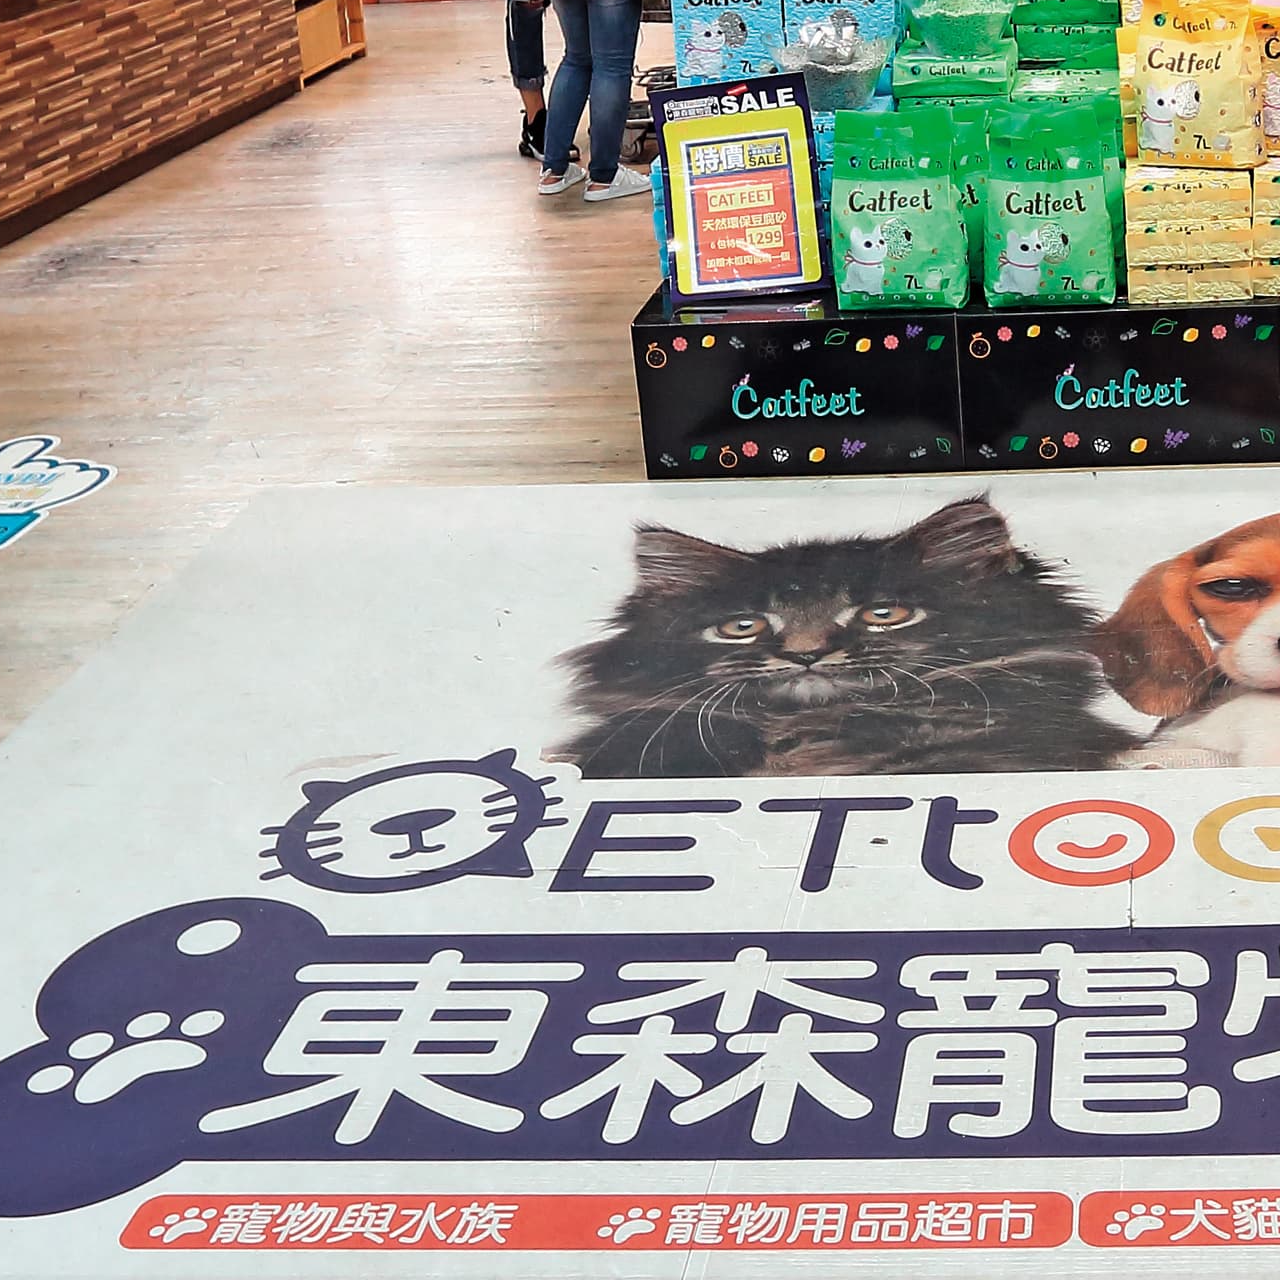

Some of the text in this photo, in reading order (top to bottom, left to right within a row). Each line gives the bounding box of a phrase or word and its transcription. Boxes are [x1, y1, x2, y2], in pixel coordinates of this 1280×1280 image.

[740, 60, 754, 74] 7L
[1146, 47, 1223, 74] Catfeet
[720, 87, 796, 115] SALE
[1193, 134, 1211, 150] 7L
[695, 143, 746, 175] 特價
[748, 154, 783, 168] SALE
[708, 189, 773, 209] CAT FEET
[848, 187, 933, 214] Catfeet
[1005, 189, 1087, 216] Catfeet
[702, 212, 788, 233] 天然環保豆腐砂
[747, 230, 783, 246] 1299
[904, 273, 924, 290] 7L
[1061, 276, 1080, 291] 7L
[730, 377, 866, 420] Catfeet
[1054, 367, 1191, 412] Catfeet
[210, 1202, 522, 1248] 寵物與水族
[663, 1199, 1038, 1246] 寵物用品超市
